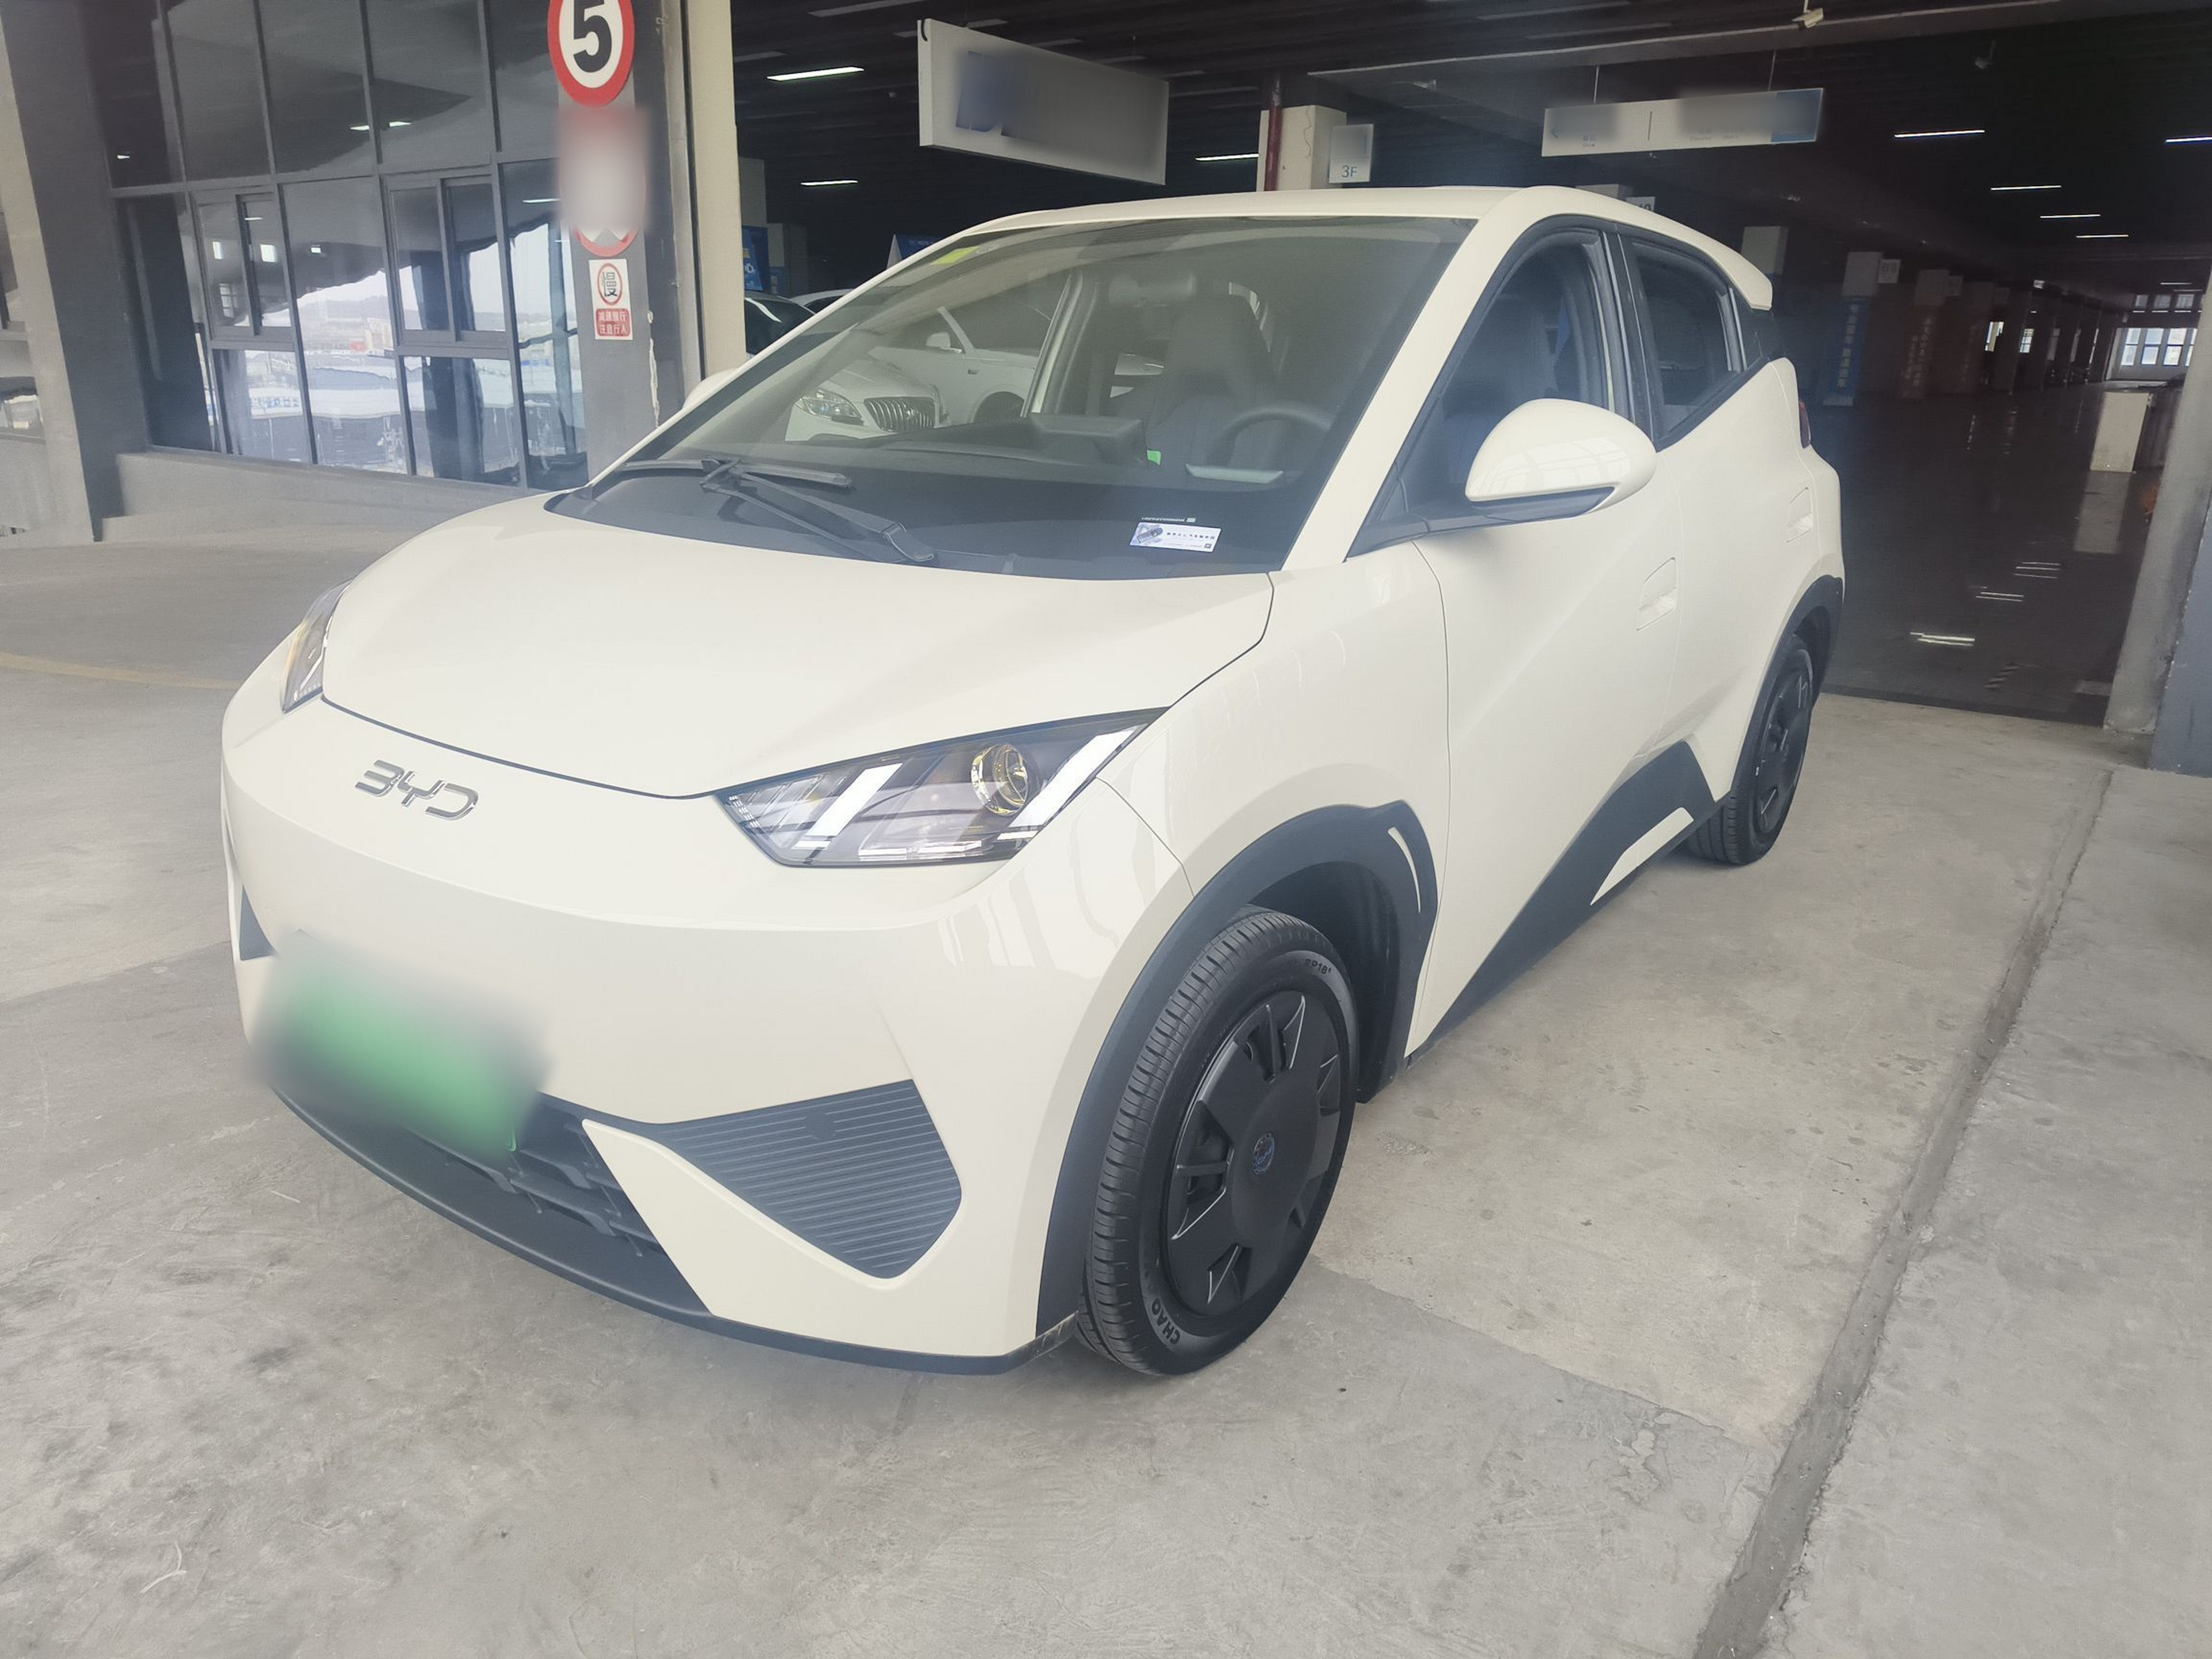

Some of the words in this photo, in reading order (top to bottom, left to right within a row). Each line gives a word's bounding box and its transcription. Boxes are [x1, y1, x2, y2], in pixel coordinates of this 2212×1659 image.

[573, 0, 612, 73] 5
[1342, 165, 1358, 178] 3F
[601, 271, 618, 297] 慢
[599, 323, 628, 335] 注意行人
[355, 759, 479, 821] BYD
